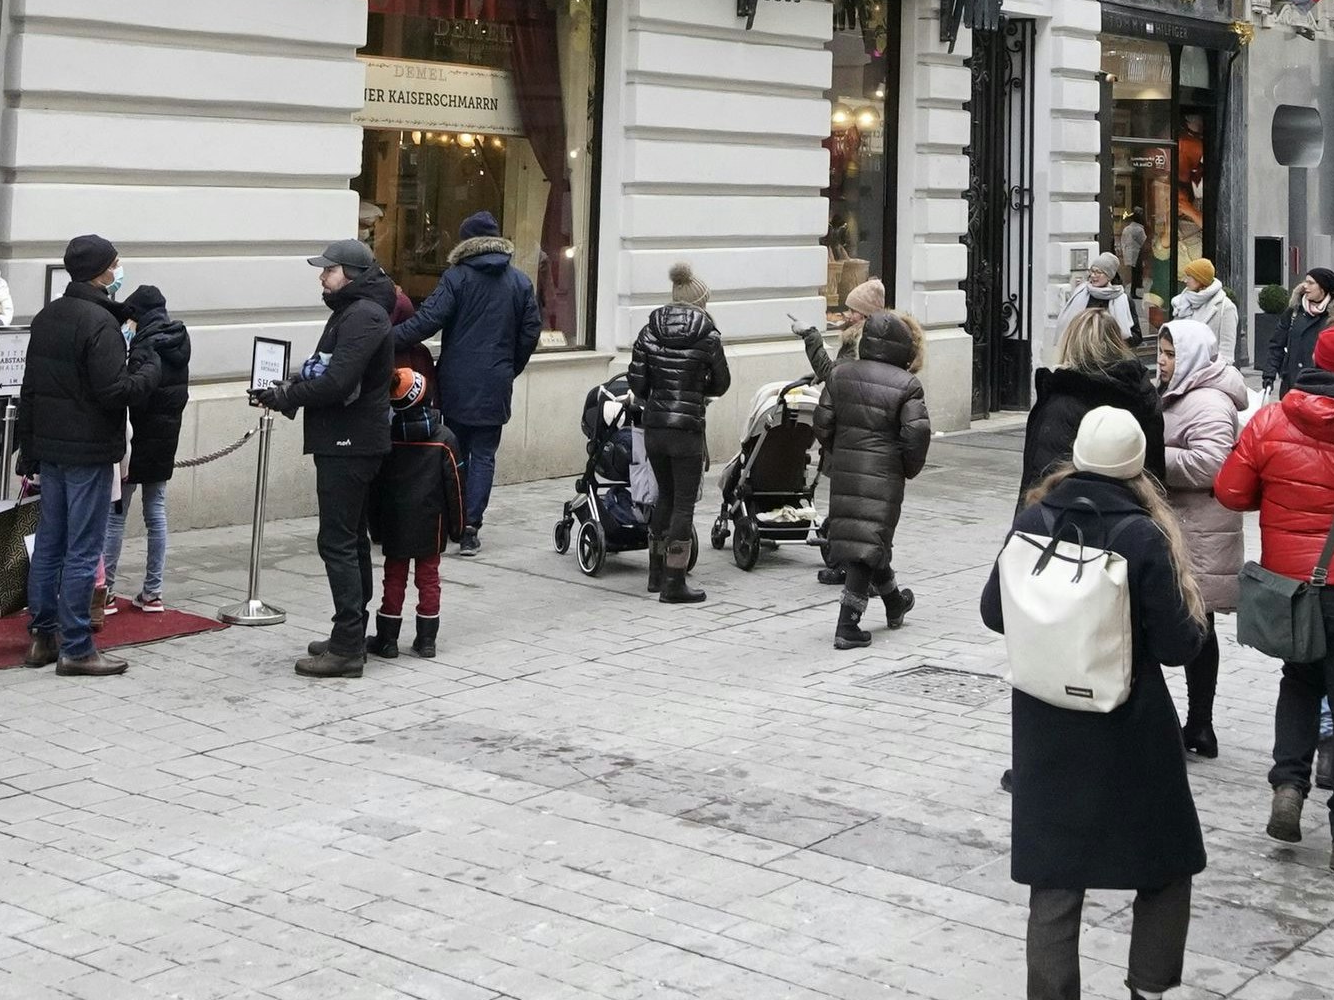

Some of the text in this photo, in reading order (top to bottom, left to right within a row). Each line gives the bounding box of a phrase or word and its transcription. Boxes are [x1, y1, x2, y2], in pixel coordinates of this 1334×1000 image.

[394, 64, 447, 82] DEMEL
[388, 89, 498, 110] KAISERSCHMARRN
[257, 378, 271, 388] SH
